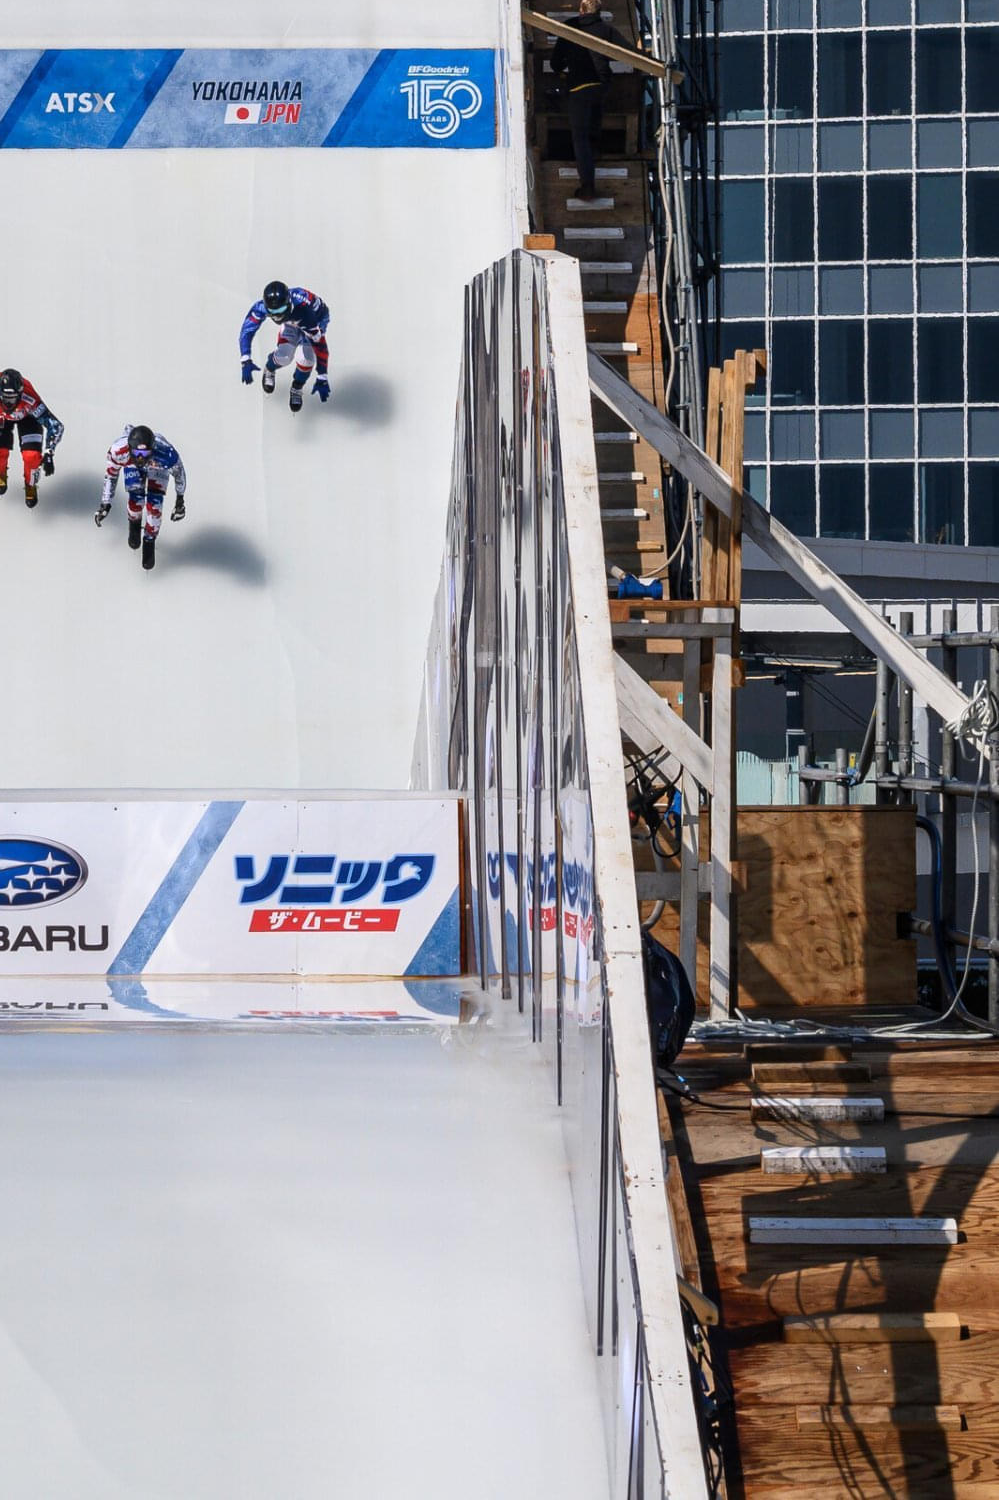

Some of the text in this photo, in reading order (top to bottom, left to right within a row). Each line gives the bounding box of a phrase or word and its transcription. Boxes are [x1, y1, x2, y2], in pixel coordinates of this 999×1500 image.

[408, 65, 470, 74] BFGoodrich
[192, 81, 301, 100] YOKOHAMA
[45, 92, 116, 113] ATSX
[262, 103, 301, 123] JPN
[400, 79, 482, 139] 150
[233, 852, 437, 905] ソニック
[269, 910, 381, 931] ザ・ムービー
